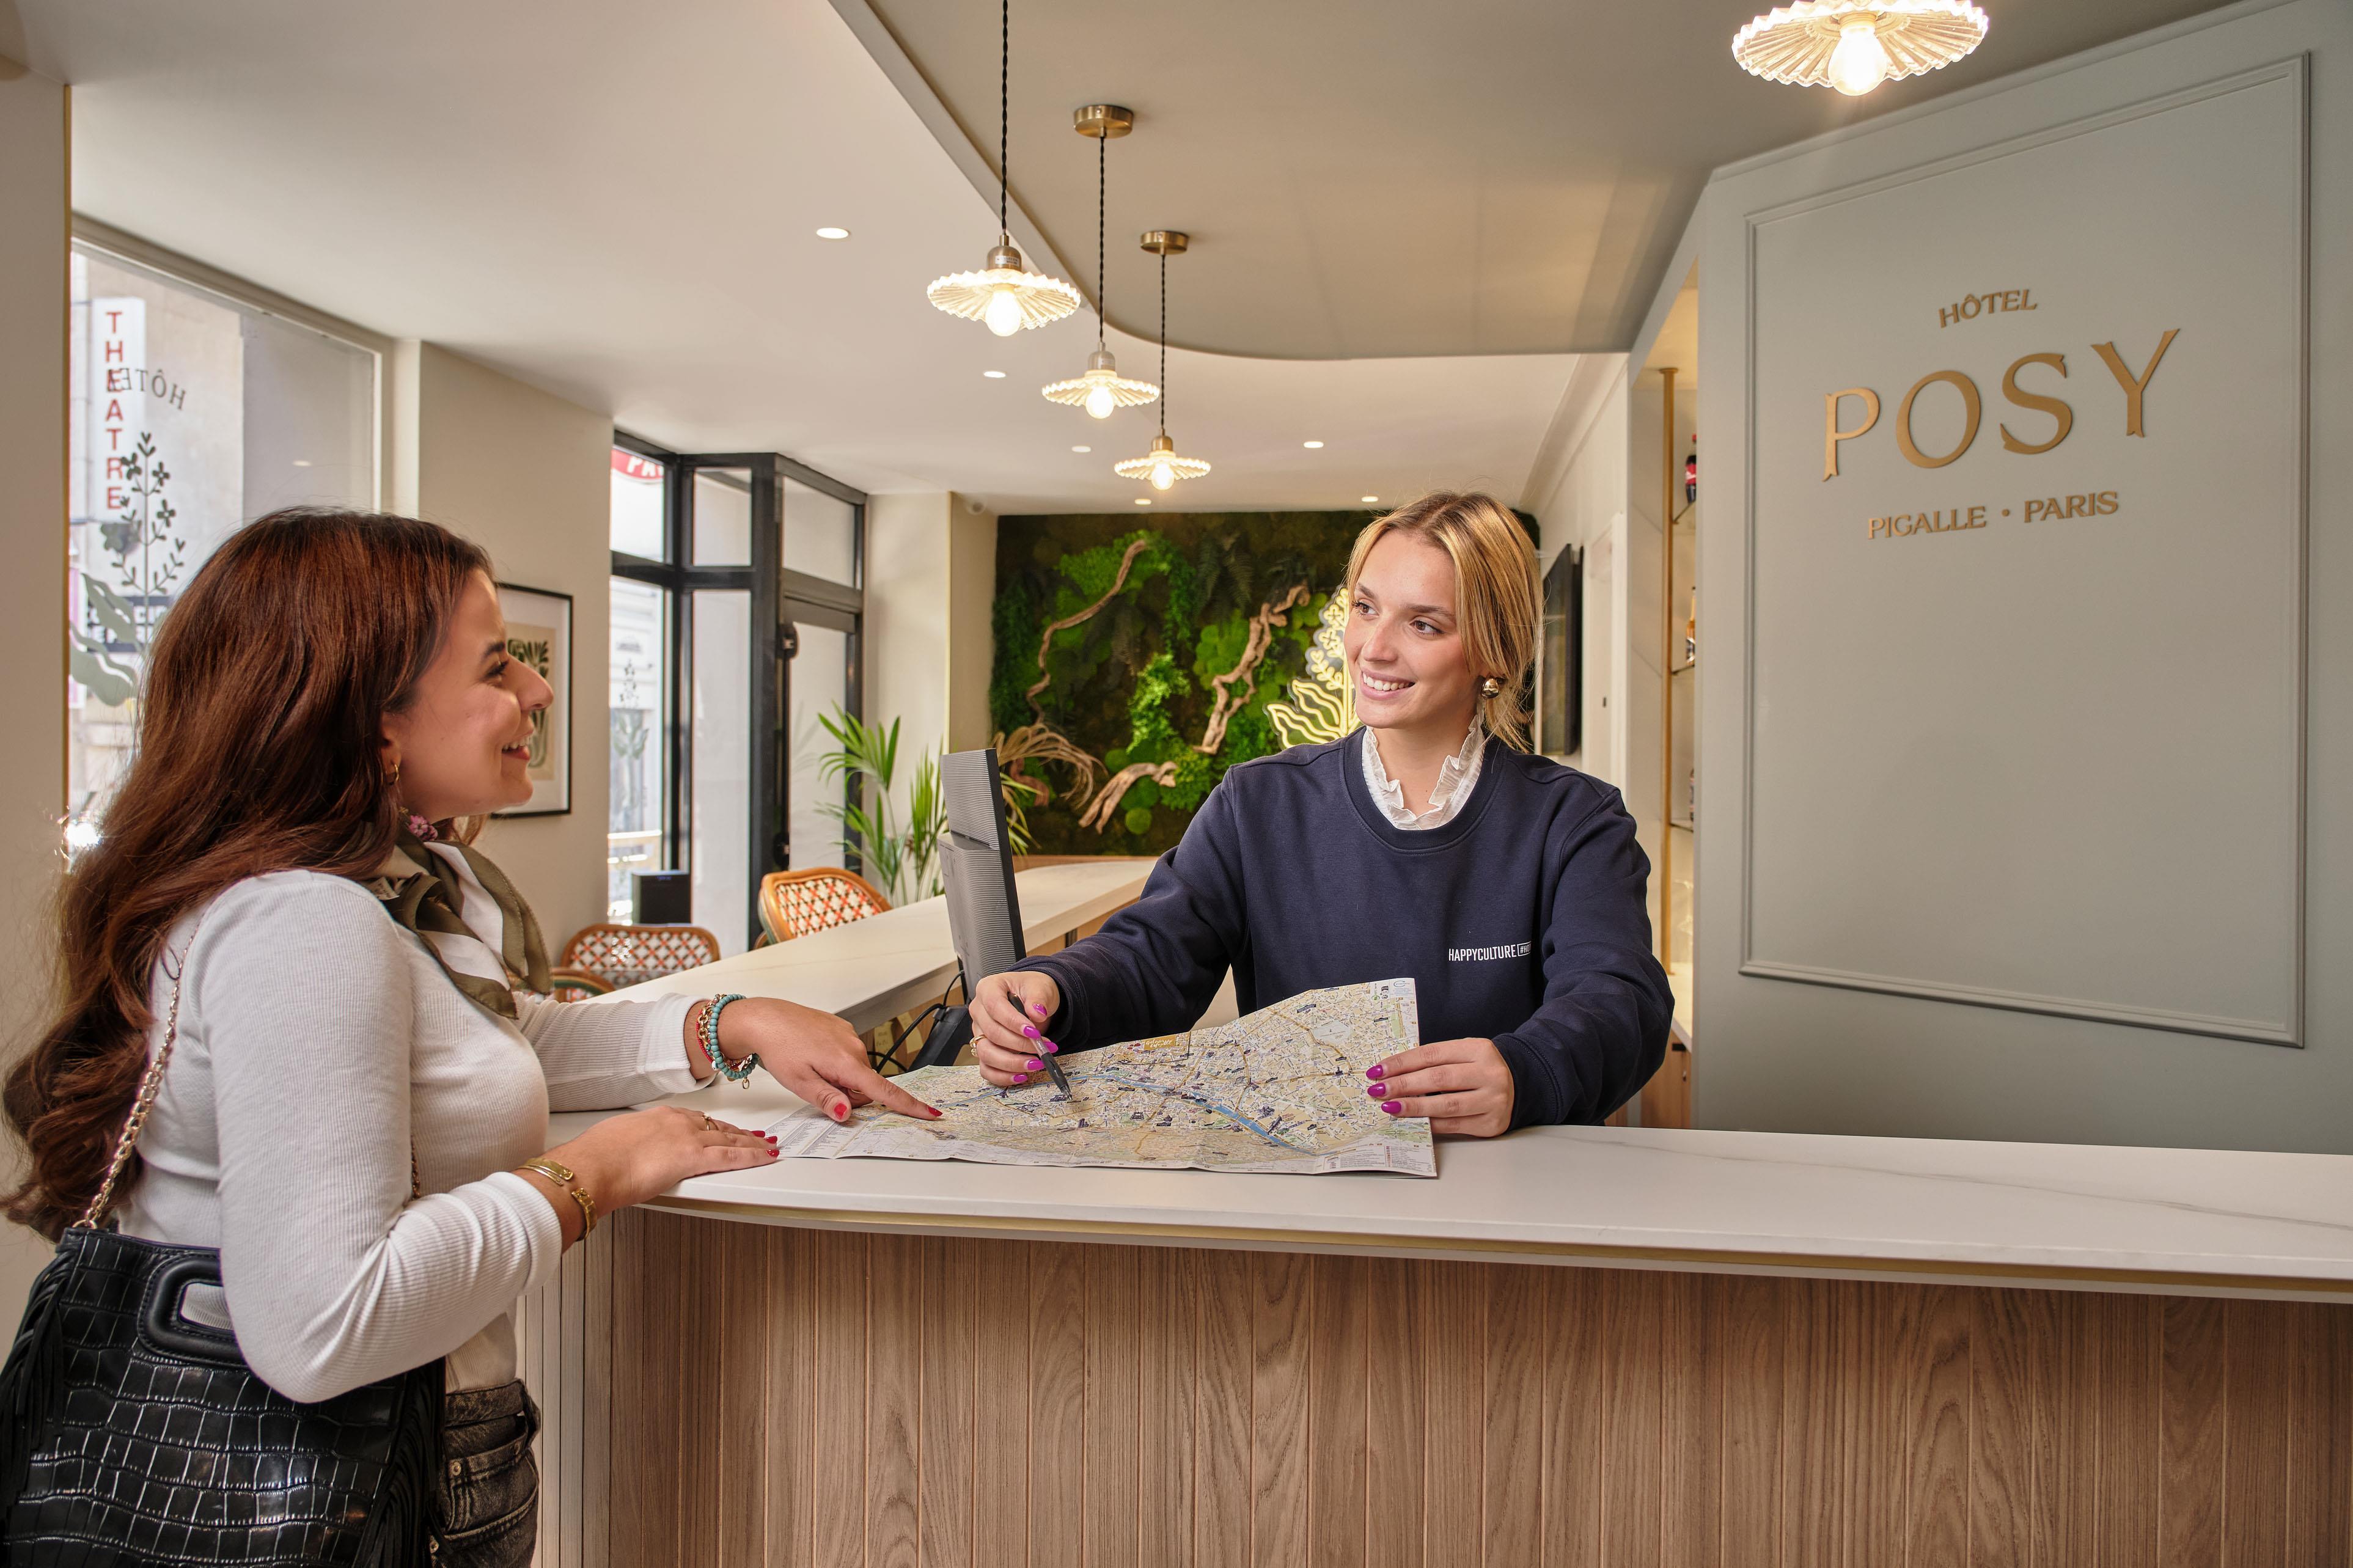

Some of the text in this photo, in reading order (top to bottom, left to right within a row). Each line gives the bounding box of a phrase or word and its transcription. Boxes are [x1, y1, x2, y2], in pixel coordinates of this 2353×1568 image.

[1938, 288, 2038, 328] HÔTEL
[105, 311, 123, 510] THEATRE
[1822, 328, 2180, 482] POSY
[1868, 490, 2118, 540] PIGALLE PARIS
[1448, 944, 1517, 961] HAPPYCULTURE
